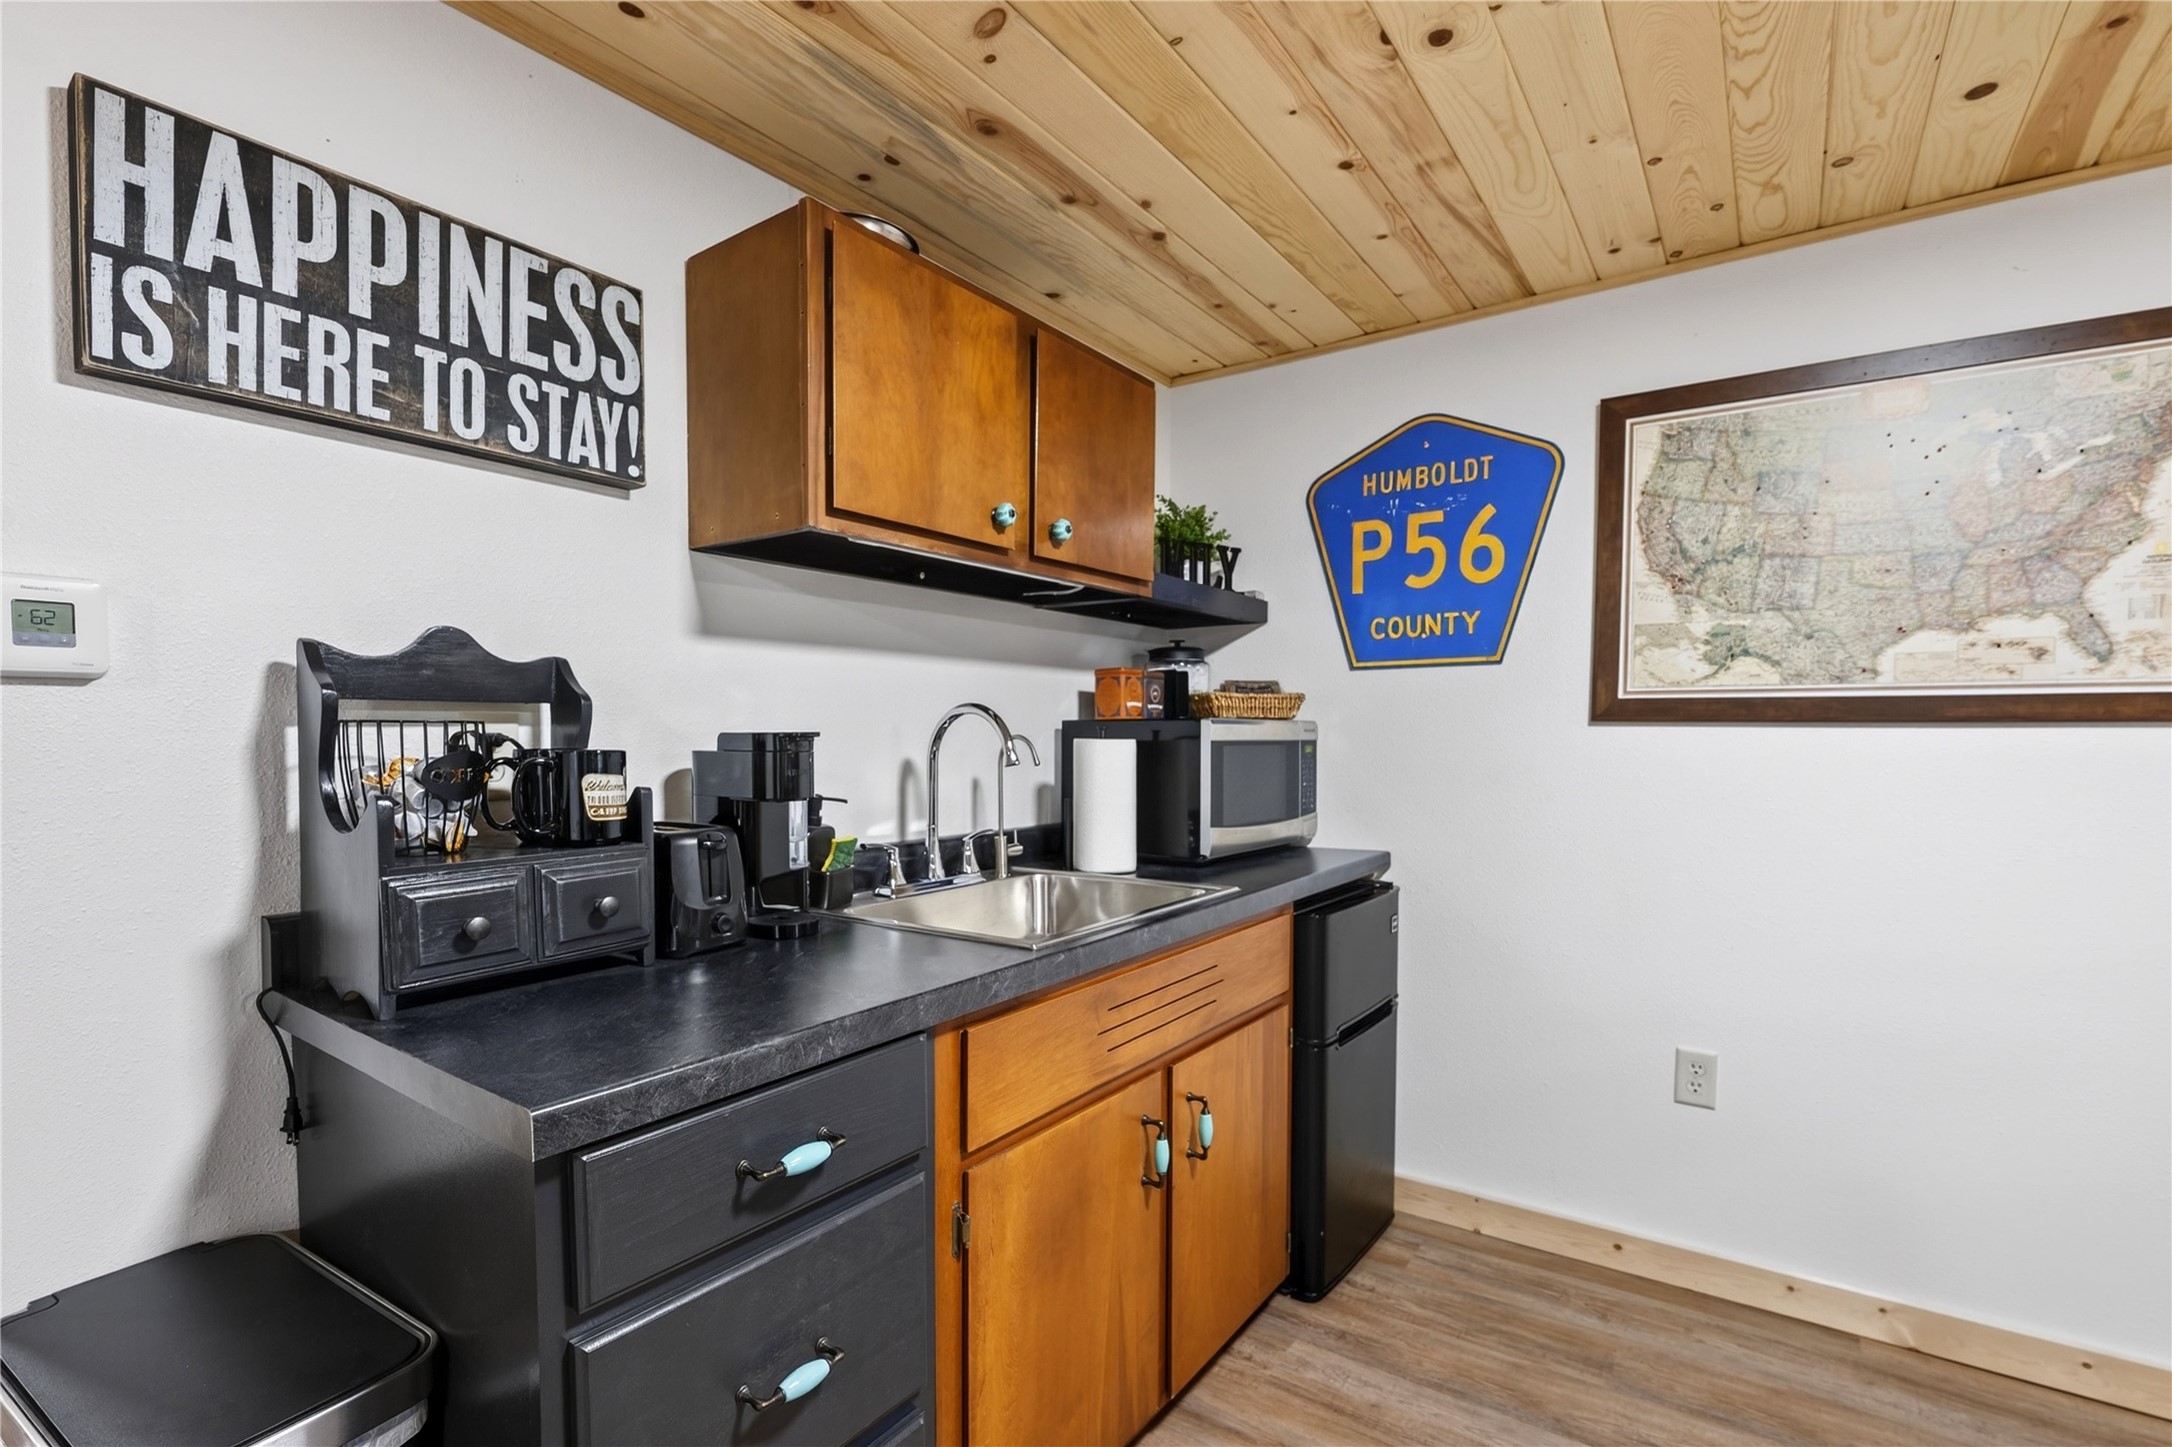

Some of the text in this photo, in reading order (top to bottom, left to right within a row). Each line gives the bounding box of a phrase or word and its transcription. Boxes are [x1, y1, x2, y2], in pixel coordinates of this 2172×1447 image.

[93, 86, 641, 397] HAPPINESS
[90, 252, 641, 479] IS HERE TO STAY!
[1362, 455, 1494, 497] HUMBOLDT
[1351, 503, 1506, 595] P56
[30, 608, 56, 626] 62
[1370, 610, 1481, 640] COUNTY
